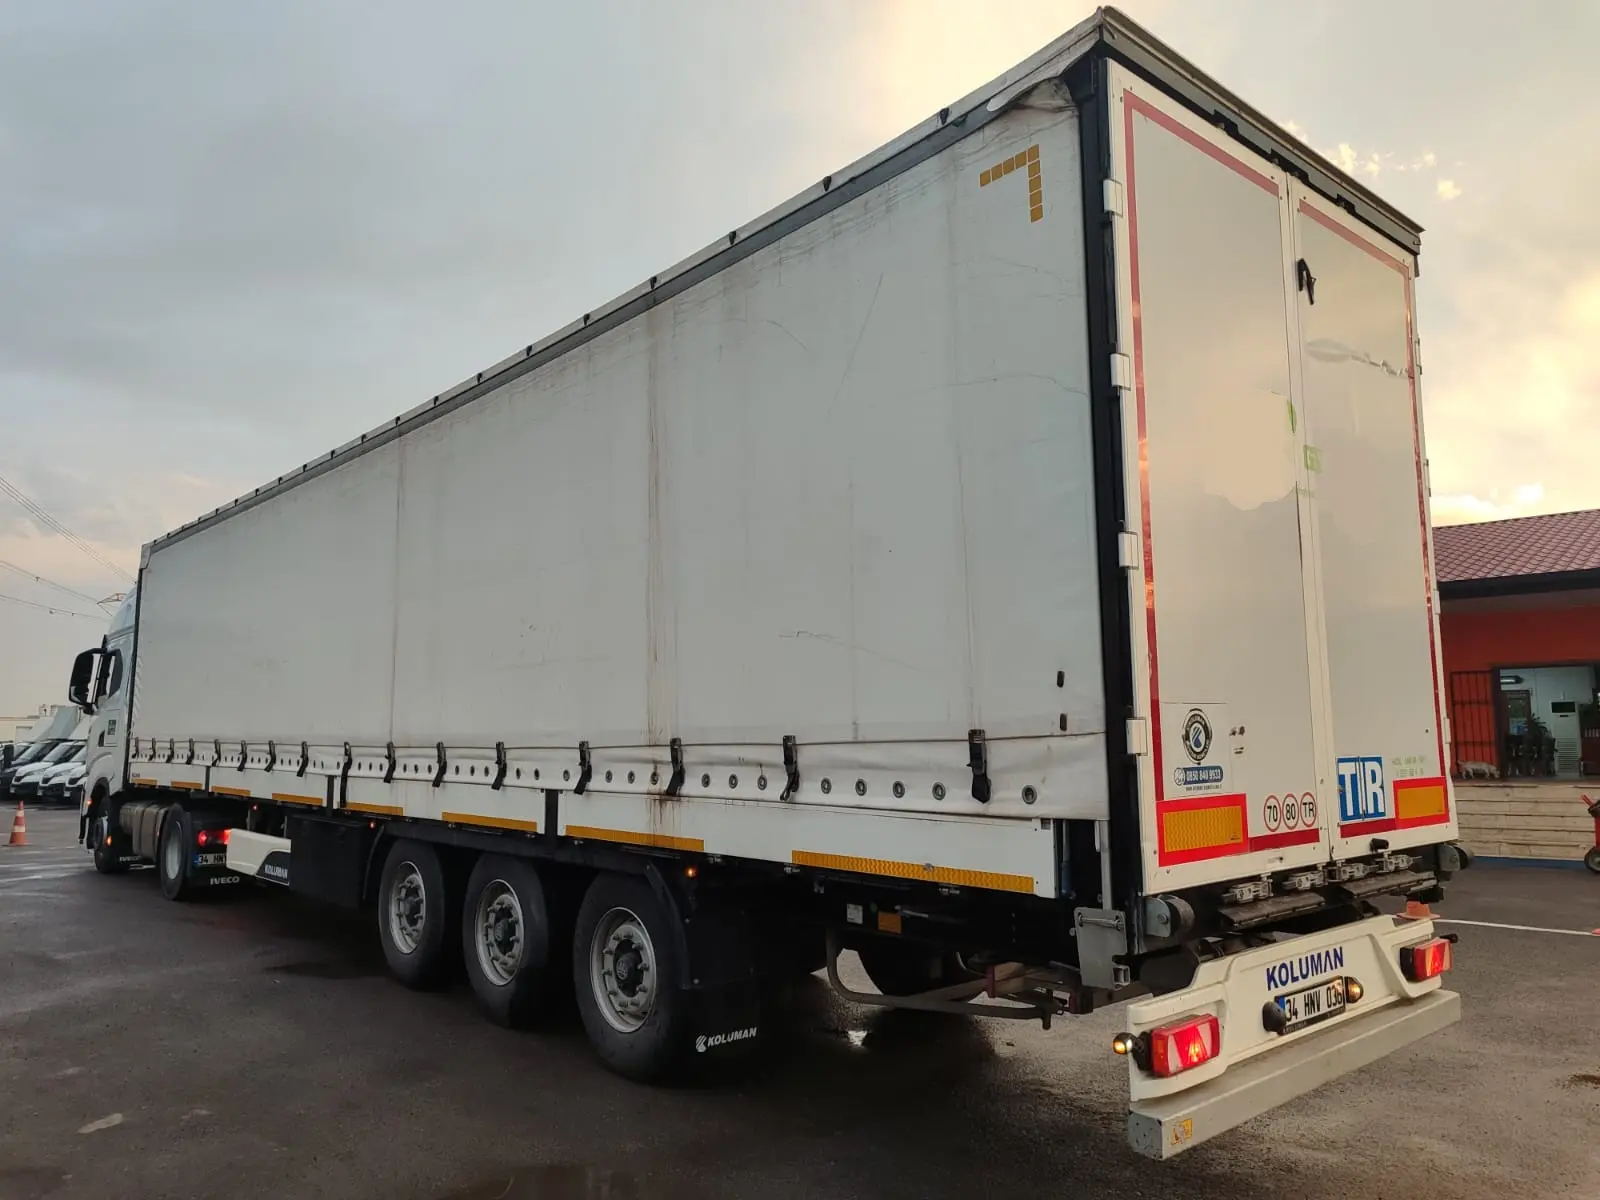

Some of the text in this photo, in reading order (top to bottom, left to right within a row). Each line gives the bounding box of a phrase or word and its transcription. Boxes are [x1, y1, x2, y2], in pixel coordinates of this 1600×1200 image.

[1338, 761, 1385, 817] TIR
[1266, 805, 1278, 822] 70
[1285, 803, 1296, 820] 80
[1302, 801, 1315, 817] TR
[199, 855, 209, 864] 34
[210, 876, 240, 885] IVECO
[1266, 946, 1344, 991] KOLUMAN
[1285, 997, 1298, 1022] 34
[1303, 989, 1321, 1017] HNV
[707, 1026, 757, 1047] KOLUMAN
